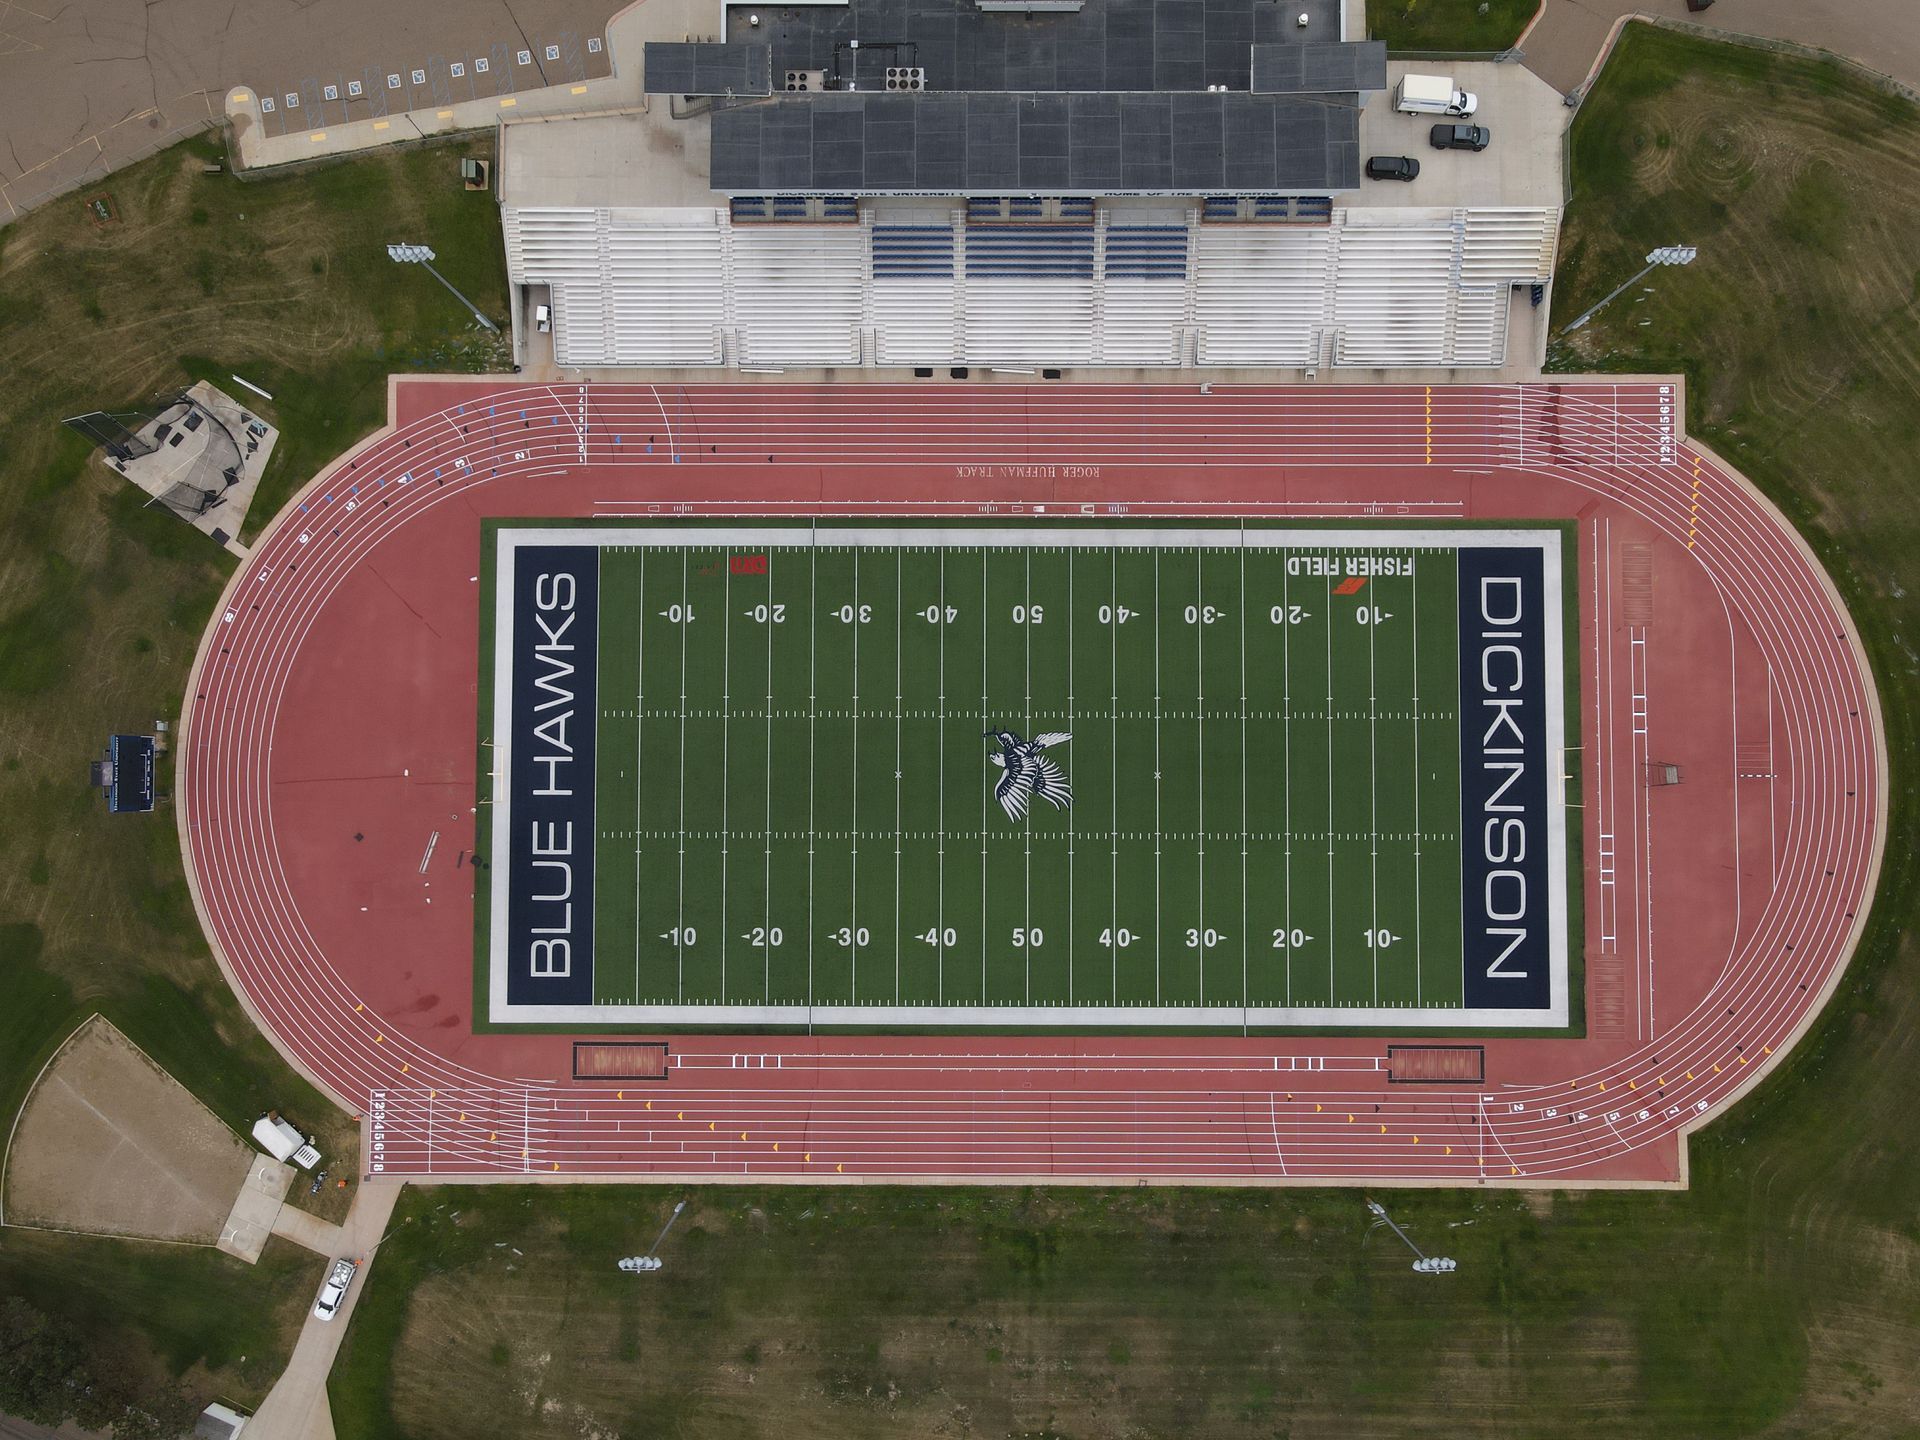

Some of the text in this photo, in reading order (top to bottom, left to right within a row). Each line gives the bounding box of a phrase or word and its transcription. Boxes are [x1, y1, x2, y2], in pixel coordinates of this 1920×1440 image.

[454, 459, 466, 468] 3
[514, 451, 525, 460] 2
[397, 476, 407, 484] 4
[956, 466, 1100, 478] ROGER HUFFMAN TRACK
[345, 501, 356, 511] 5
[299, 533, 309, 544] 6
[258, 571, 268, 581] 7
[1287, 557, 1413, 576] FISHER FIELD
[224, 612, 234, 623] 8
[668, 604, 696, 623] 10
[754, 604, 786, 623] 20
[840, 604, 872, 623] 30
[926, 605, 958, 624] 40
[1012, 605, 1044, 624] 50
[1099, 605, 1130, 624] 40
[1184, 605, 1216, 624] 30
[1270, 605, 1302, 624] 20
[1356, 606, 1383, 625] 10
[530, 573, 576, 977] BLUE HAWKS
[1481, 577, 1527, 977] DICKINSON
[670, 927, 697, 946] 10
[752, 927, 783, 946] 20
[838, 927, 870, 946] 30
[925, 927, 957, 946] 40
[1012, 928, 1043, 947] 50
[1099, 928, 1130, 947] 40
[1185, 928, 1217, 947] 30
[1272, 928, 1303, 947] 20
[1363, 928, 1391, 947] 10
[1546, 1109, 1557, 1117] 3
[1639, 1110, 1650, 1119] 6
[1669, 1106, 1679, 1114] 7
[1697, 1101, 1708, 1110] 8
[1609, 1112, 1620, 1120] 5
[375, 1122, 385, 1130] 4
